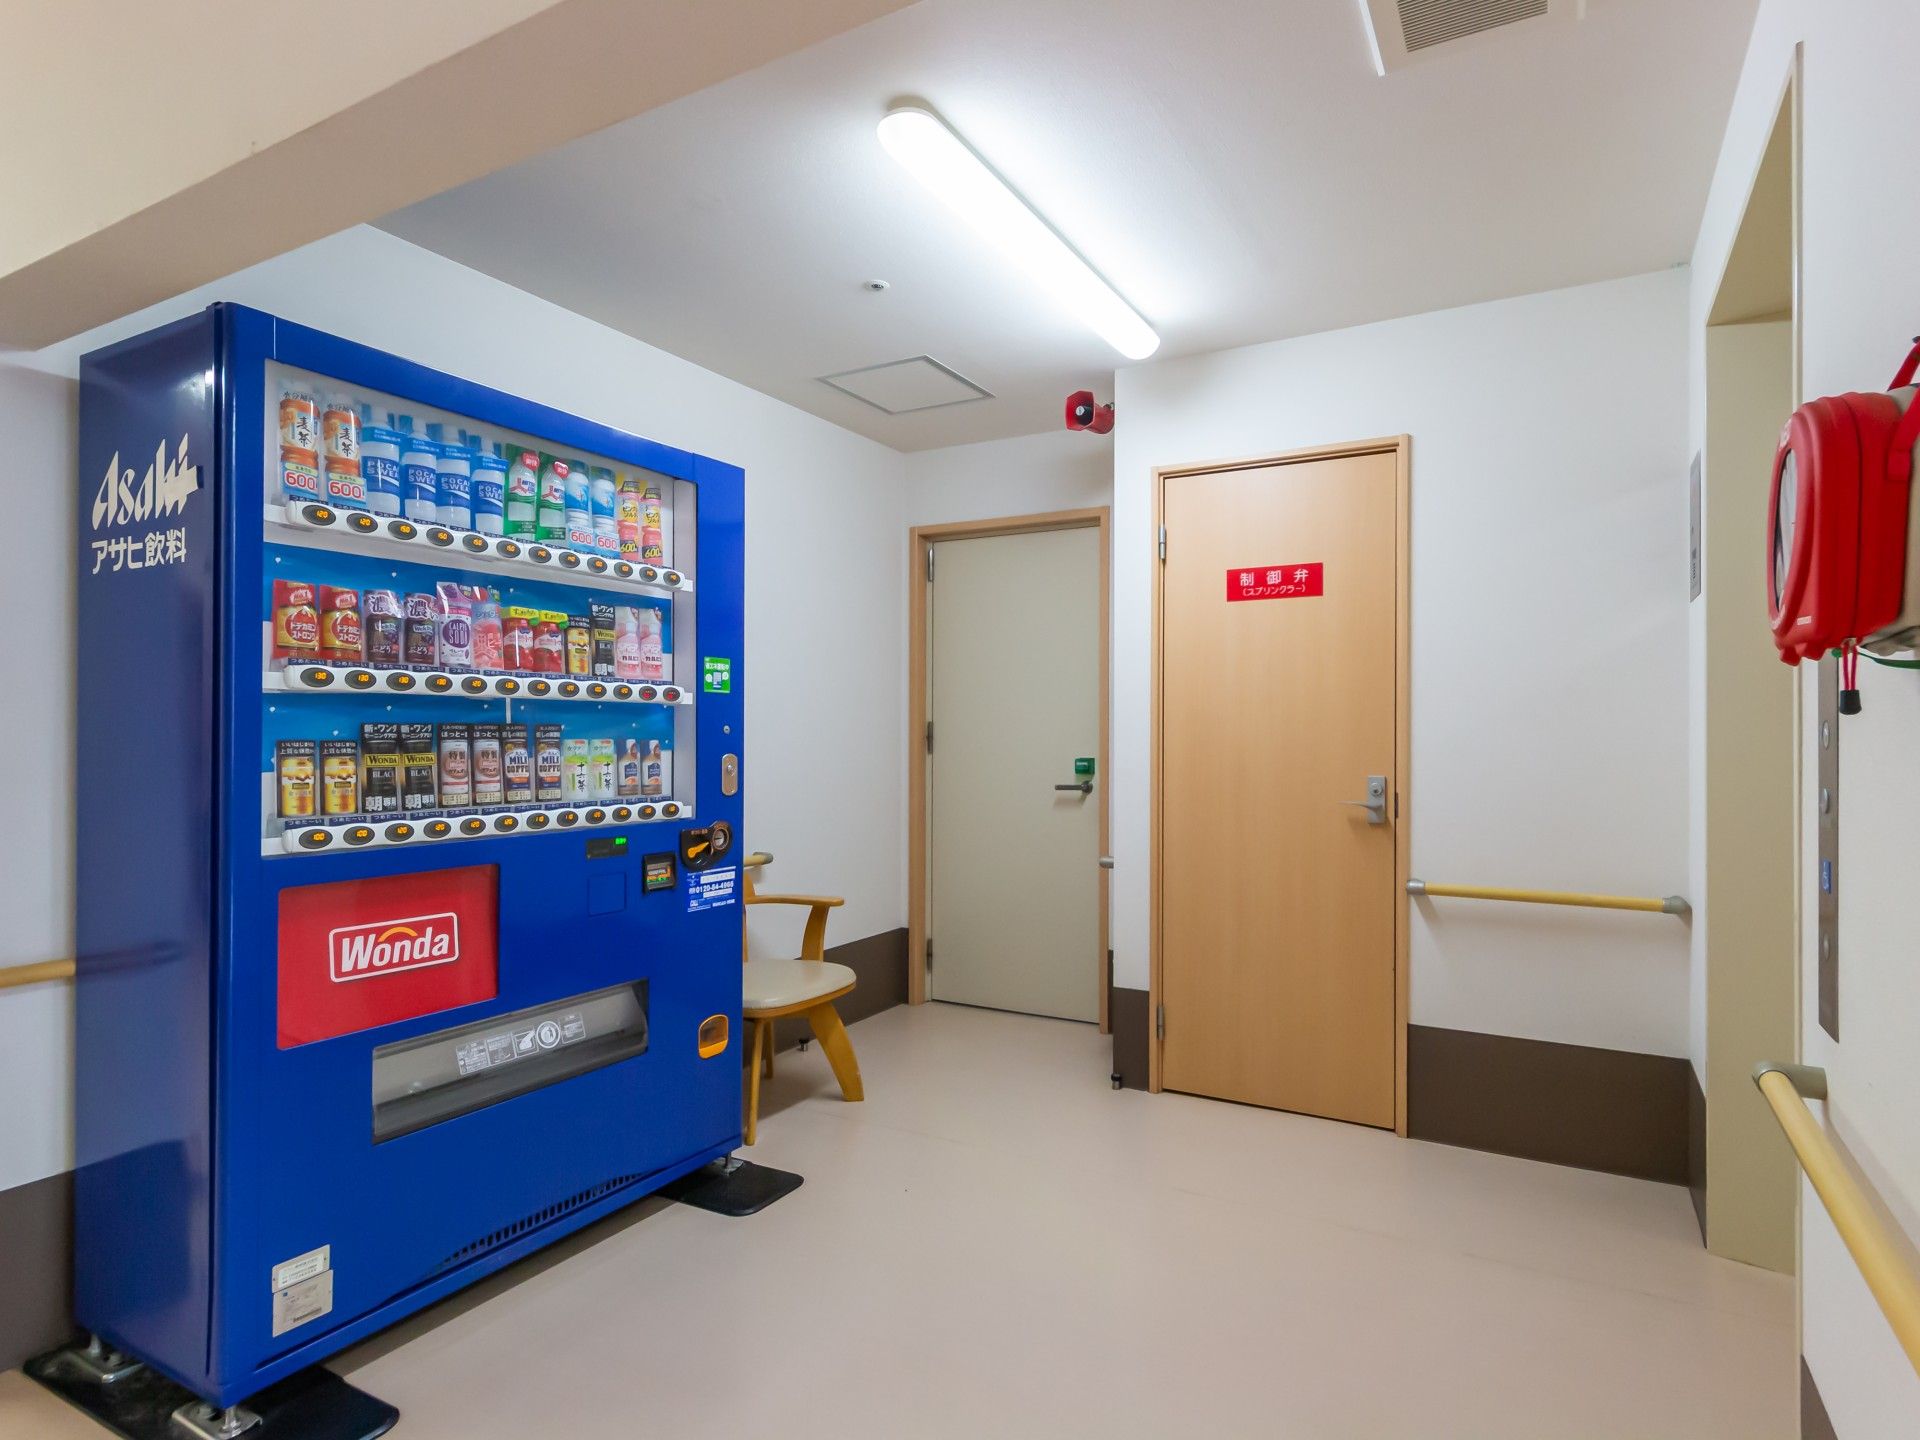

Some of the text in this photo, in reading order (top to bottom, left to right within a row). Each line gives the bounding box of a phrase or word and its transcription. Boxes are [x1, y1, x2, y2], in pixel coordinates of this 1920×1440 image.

[296, 416, 311, 447] 麦茶
[340, 427, 354, 457] 麦茶
[92, 432, 199, 531] Asahi
[286, 472, 315, 490] 600
[329, 481, 361, 499] 600
[571, 531, 592, 545] 600
[598, 536, 618, 550] 600
[92, 527, 187, 574] アサヒ飲料
[1240, 568, 1309, 586] 制御弁
[1243, 584, 1306, 596] （スプリンクラー）
[368, 755, 397, 764] WONDA
[406, 754, 434, 763] WONDA
[576, 762, 587, 792] 十六茶
[603, 761, 612, 791] 十六茶
[342, 927, 450, 973] Wonda
